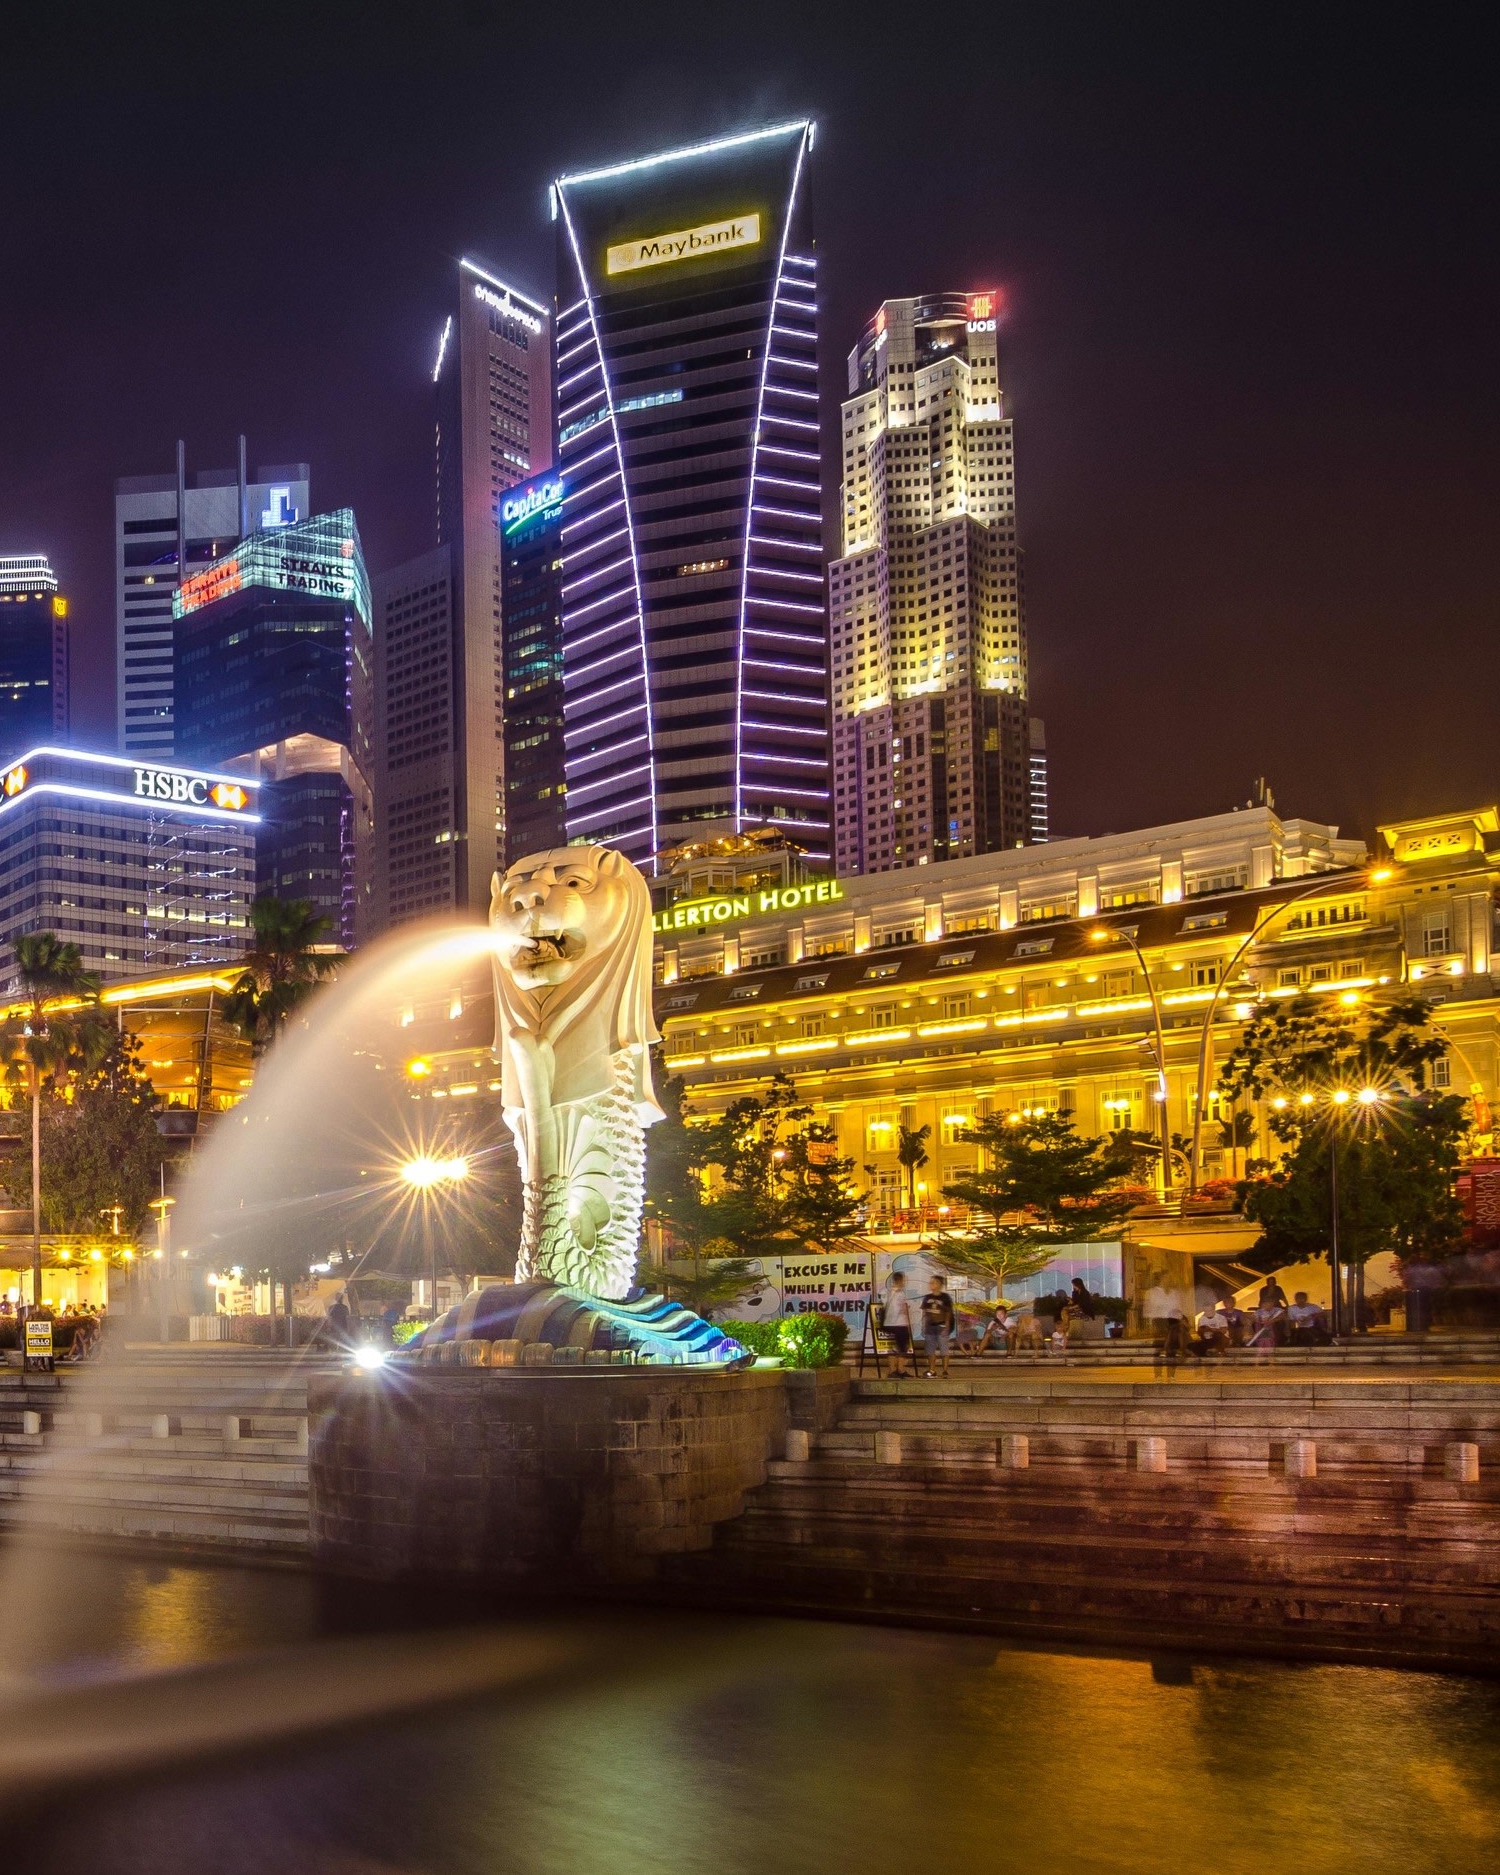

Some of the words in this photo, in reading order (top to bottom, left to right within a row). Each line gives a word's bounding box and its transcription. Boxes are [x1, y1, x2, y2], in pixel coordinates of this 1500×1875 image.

[639, 224, 745, 260] Maybank
[967, 320, 997, 333] UOB
[180, 560, 239, 596] STRAITS
[280, 558, 346, 578] STRAITS
[182, 575, 242, 609] TRADING
[276, 572, 344, 594] TRADING
[133, 768, 208, 804] HSBC
[760, 880, 844, 912] HOTEL
[844, 1263, 867, 1275] ME
[785, 1283, 825, 1295] WHILE
[829, 1282, 836, 1296] I
[839, 1282, 872, 1293] TAKE
[785, 1301, 795, 1313] A
